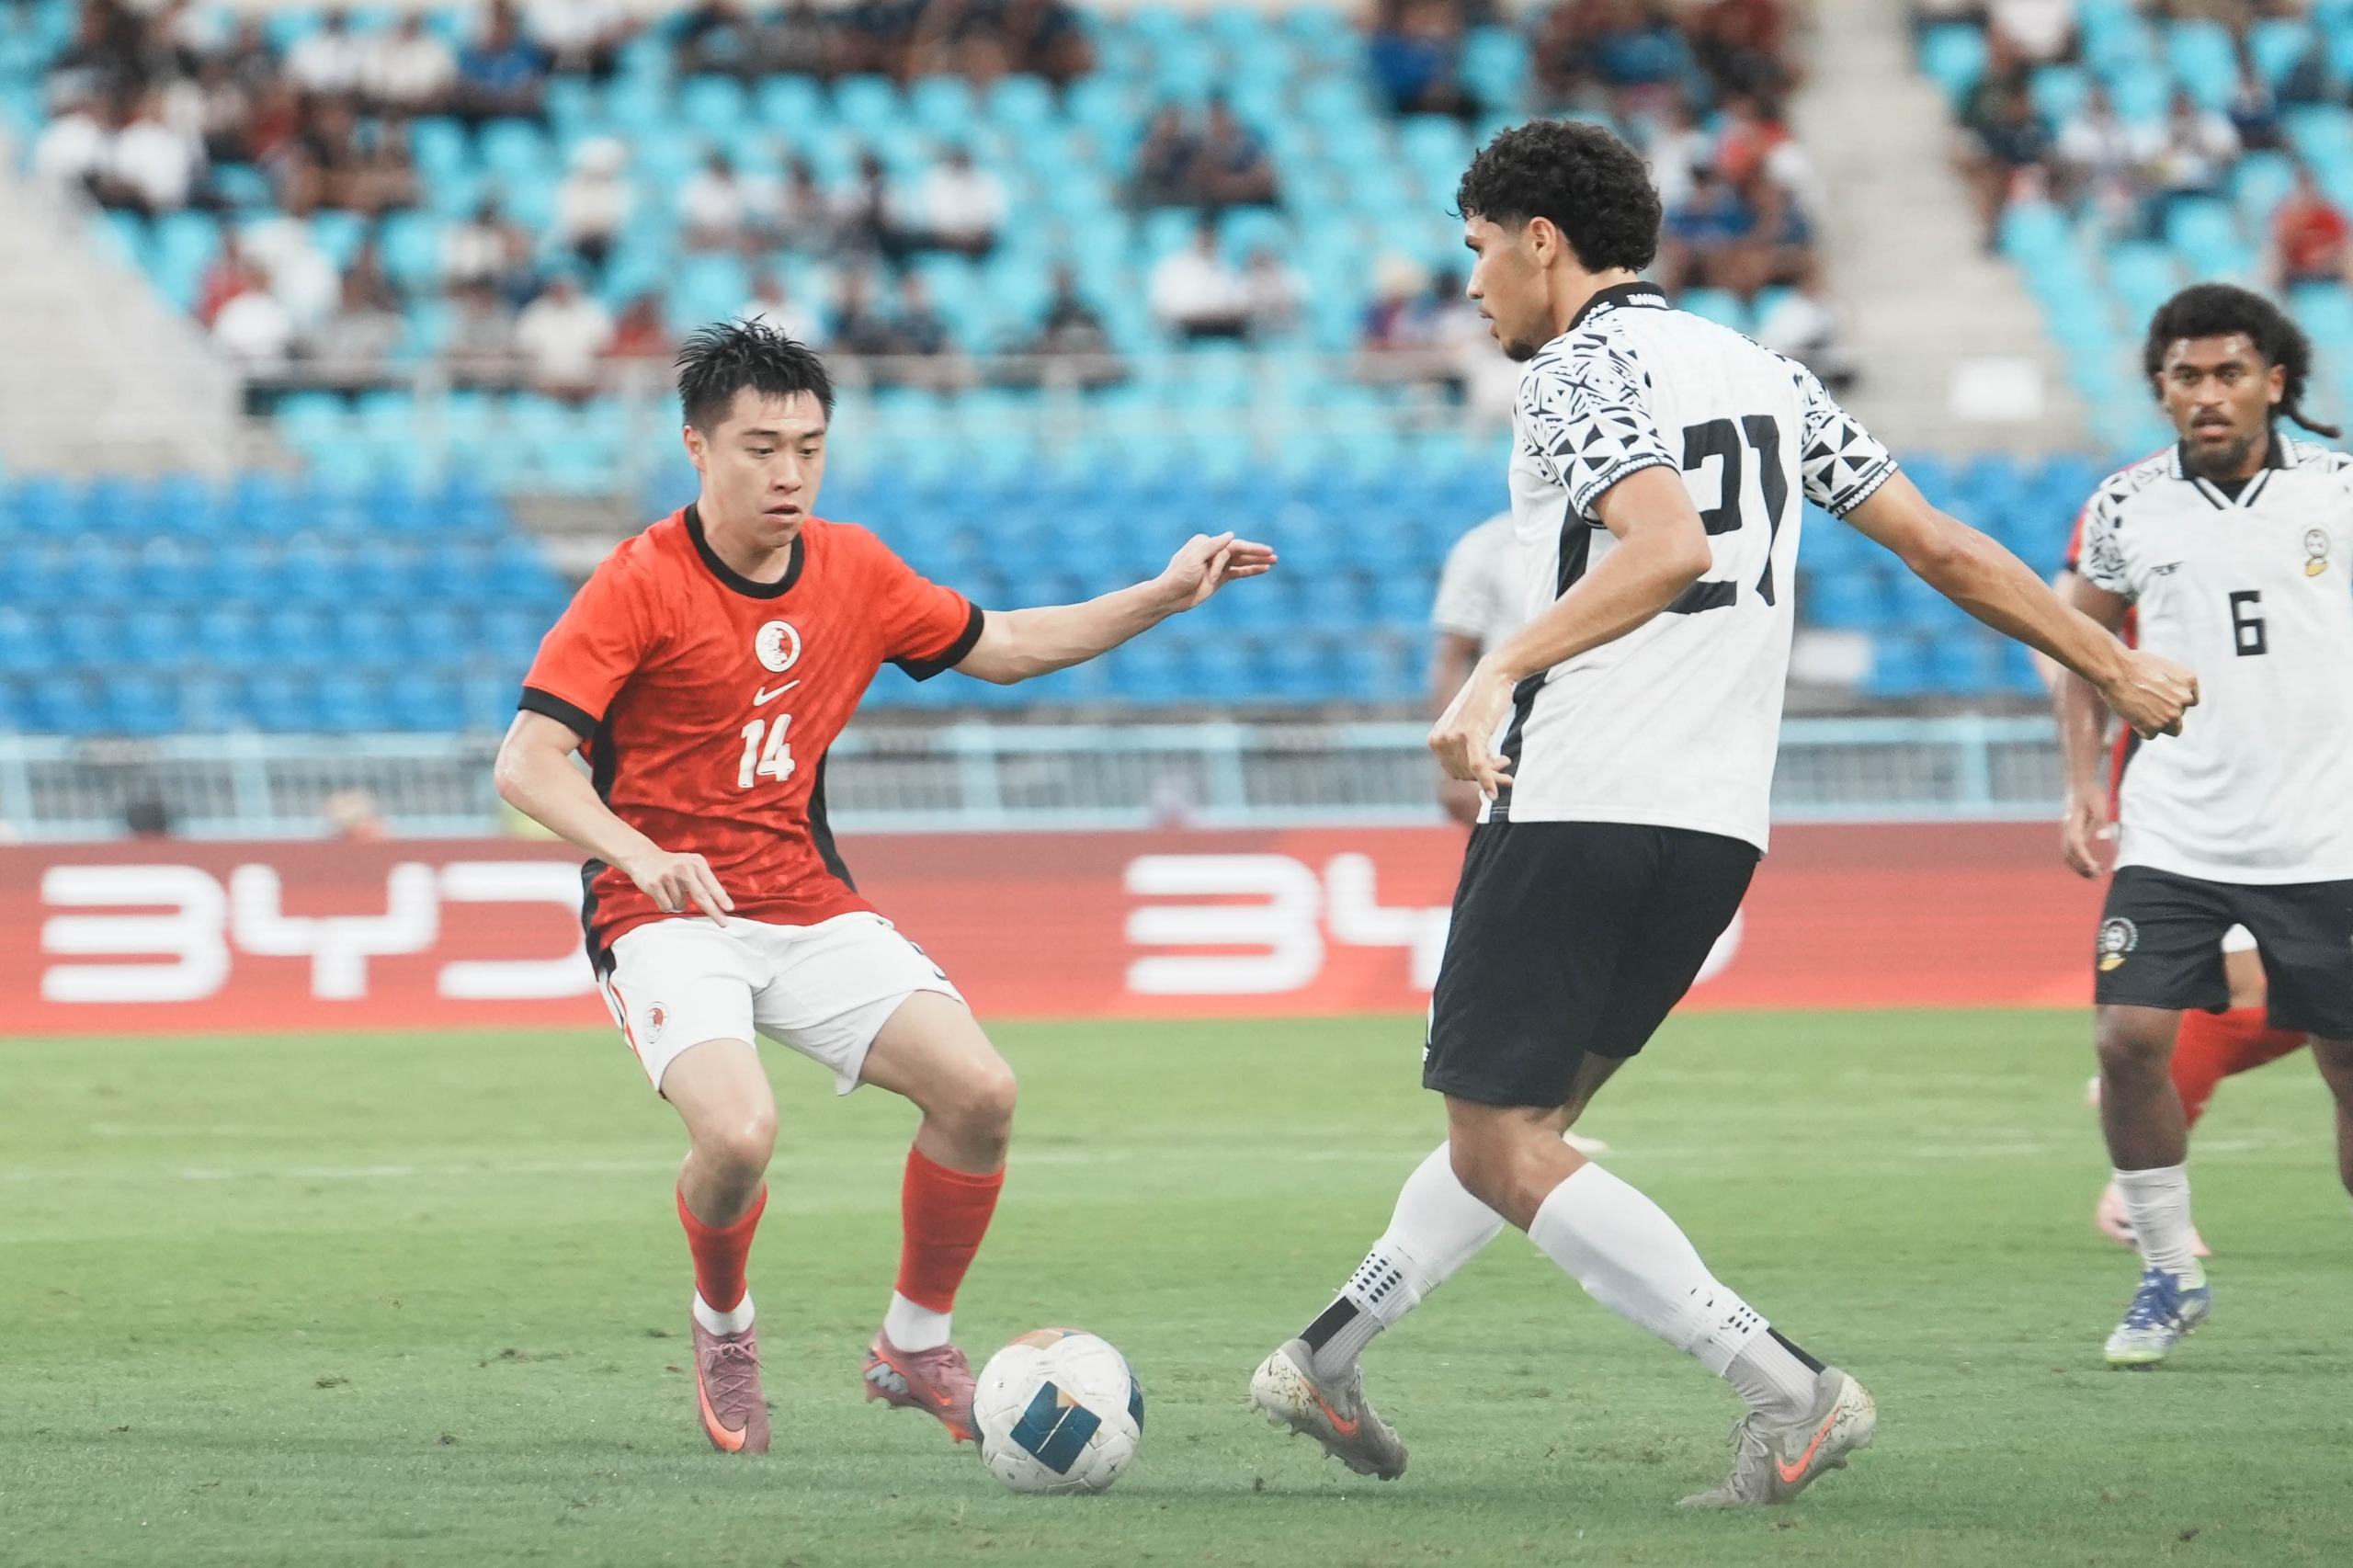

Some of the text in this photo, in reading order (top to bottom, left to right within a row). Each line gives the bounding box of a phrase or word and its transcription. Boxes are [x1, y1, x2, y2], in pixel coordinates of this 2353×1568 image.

[1665, 415, 1788, 614] 21
[2229, 590, 2268, 656] 6
[737, 714, 795, 788] 14
